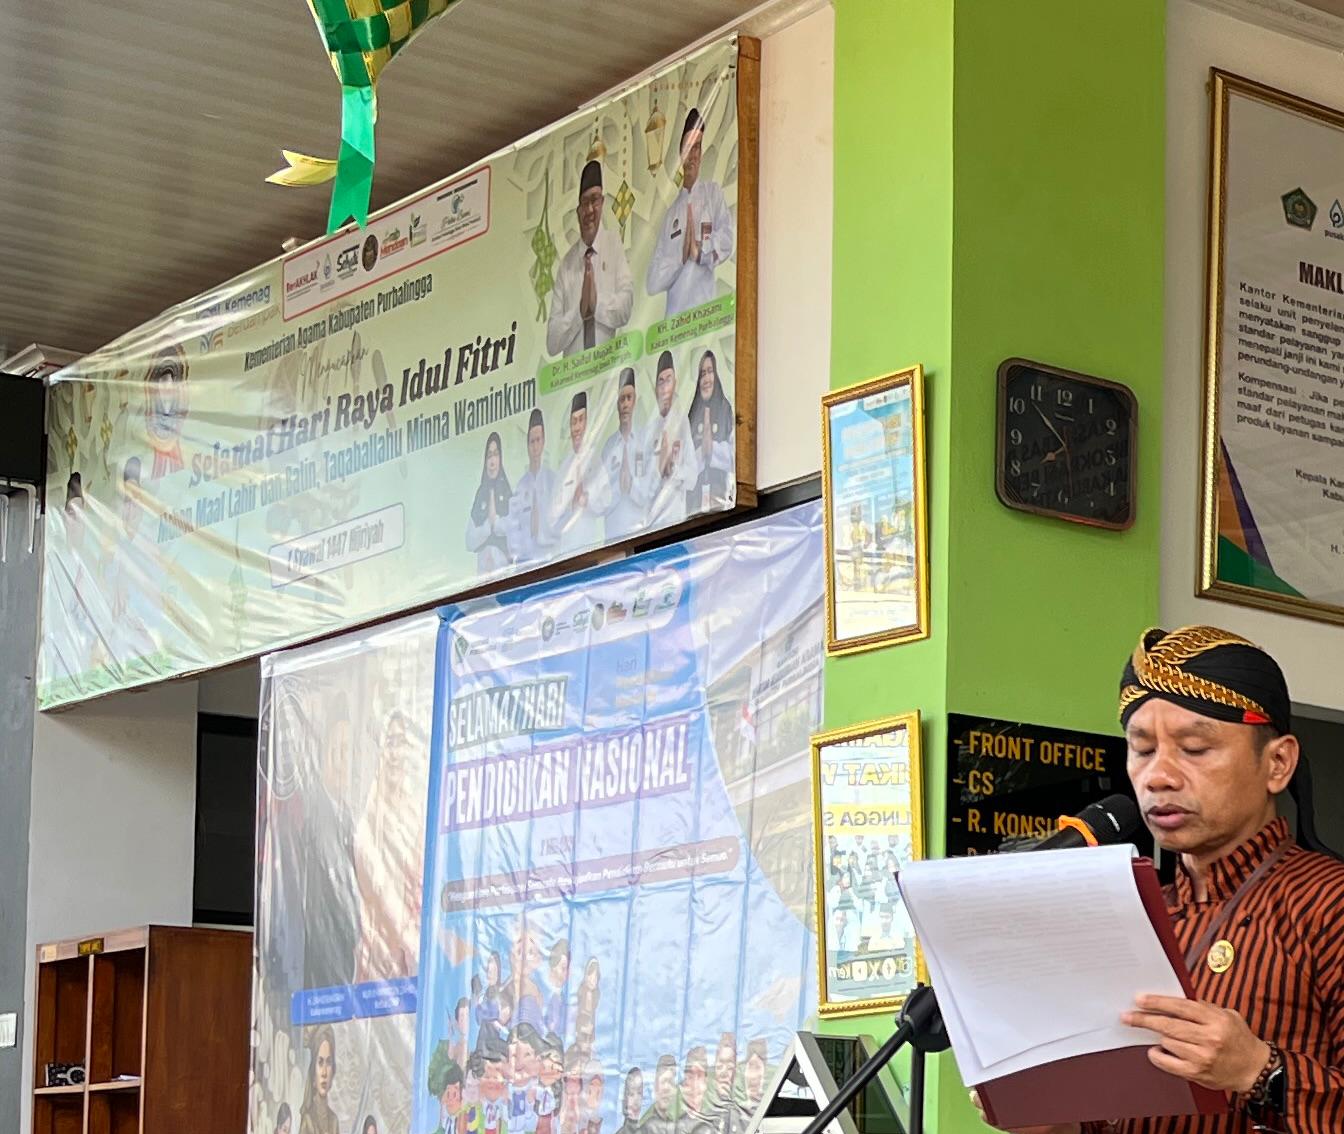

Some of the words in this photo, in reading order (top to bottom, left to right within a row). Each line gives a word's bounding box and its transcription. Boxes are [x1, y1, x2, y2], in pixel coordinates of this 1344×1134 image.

[1239, 282, 1277, 301] Kantor
[243, 332, 296, 372] Kementerian
[297, 319, 327, 350] Agama
[328, 300, 376, 337] Kabupaten
[377, 272, 433, 316] Purbalingga
[189, 419, 280, 488] Selamat
[278, 395, 331, 456] Hari
[334, 382, 394, 432] Raya
[398, 347, 453, 408] Idul
[454, 320, 518, 386] Fitri
[1009, 396, 1026, 415] 10
[1030, 383, 1042, 402] 11
[1057, 388, 1073, 407] 12
[323, 426, 402, 484] Taqaballahu
[406, 409, 450, 454] Minna
[454, 377, 537, 437] Waminkum
[1010, 428, 1023, 446] 9
[448, 687, 527, 748] SELAMAT
[526, 677, 568, 730] HARI
[969, 730, 1034, 762] FRONT
[1040, 740, 1106, 771] OFFICE
[445, 748, 572, 829] PENDIDIKAN
[575, 722, 689, 804] NASIONAL
[968, 769, 994, 795] CS
[967, 808, 987, 834] R.
[993, 811, 1060, 839] KONSU
